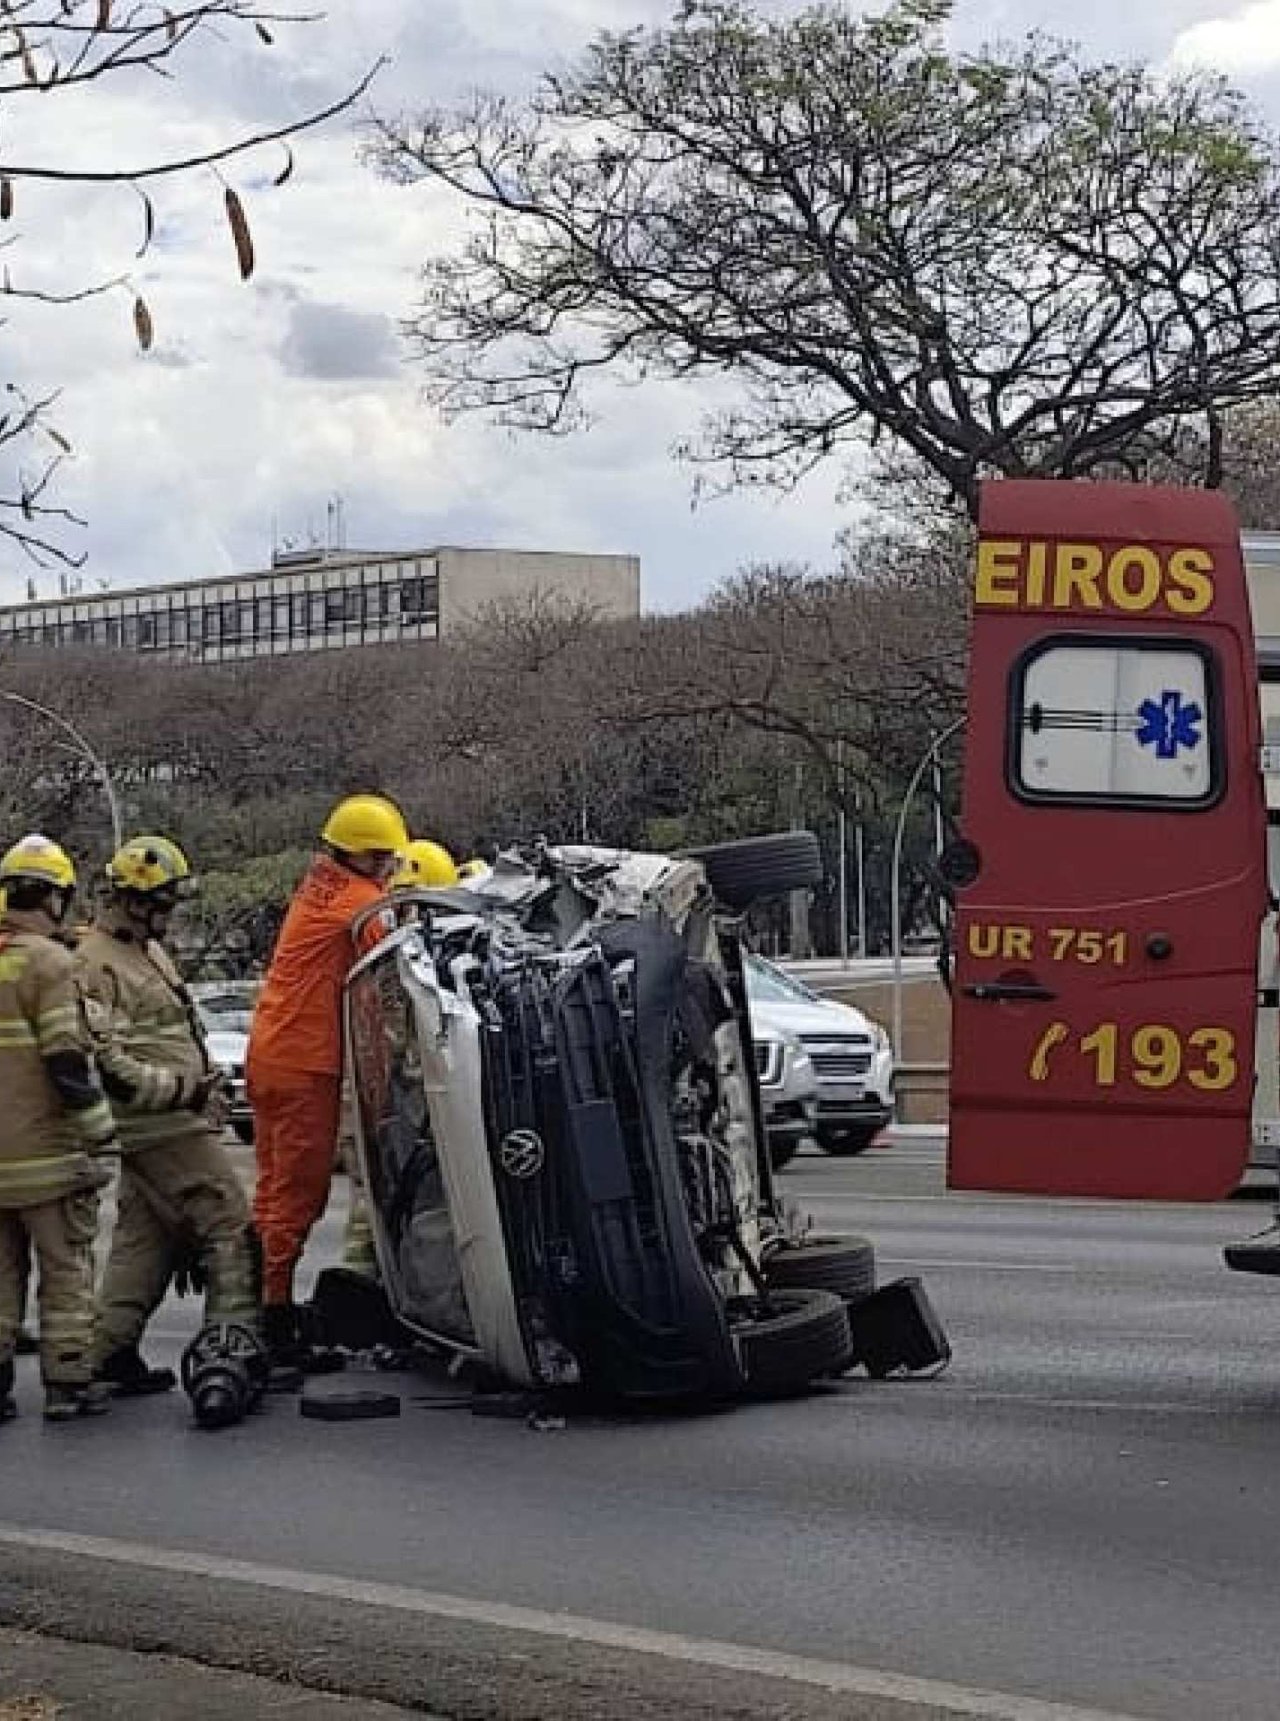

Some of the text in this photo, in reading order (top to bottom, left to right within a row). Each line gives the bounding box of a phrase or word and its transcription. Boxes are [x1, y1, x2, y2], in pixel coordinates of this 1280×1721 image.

[976, 541, 1214, 613] EIROS
[969, 925, 1127, 965] UR 751
[1080, 1023, 1236, 1089] 193
